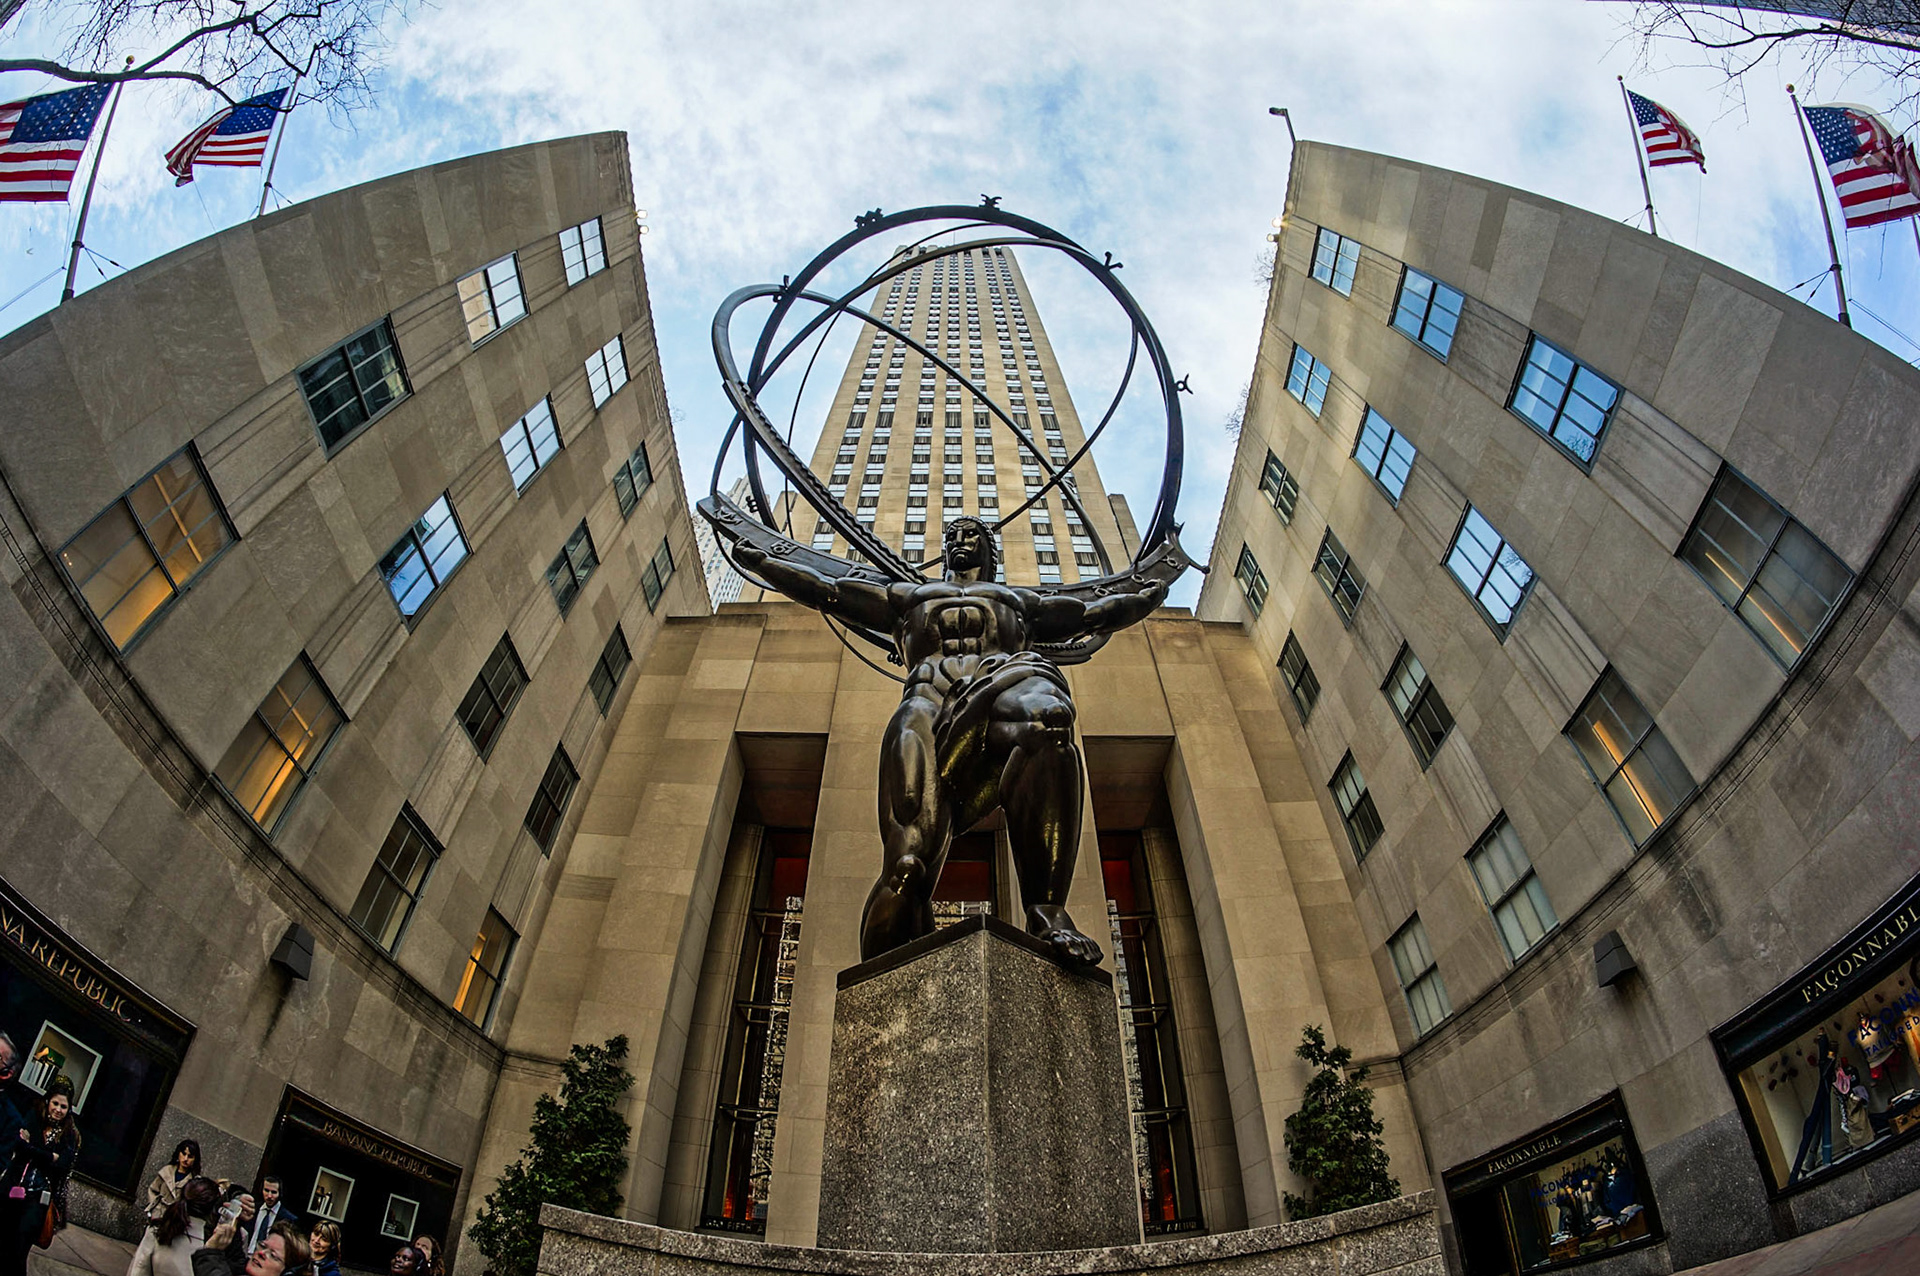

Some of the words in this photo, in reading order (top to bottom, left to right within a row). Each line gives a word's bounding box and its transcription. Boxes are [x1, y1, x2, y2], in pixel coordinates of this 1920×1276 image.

[30, 936, 131, 1023] REPUBLIC
[323, 1120, 379, 1154] BANANA
[380, 1147, 433, 1180] REPUBLIC
[1487, 1134, 1562, 1173] FAÇONNABLE
